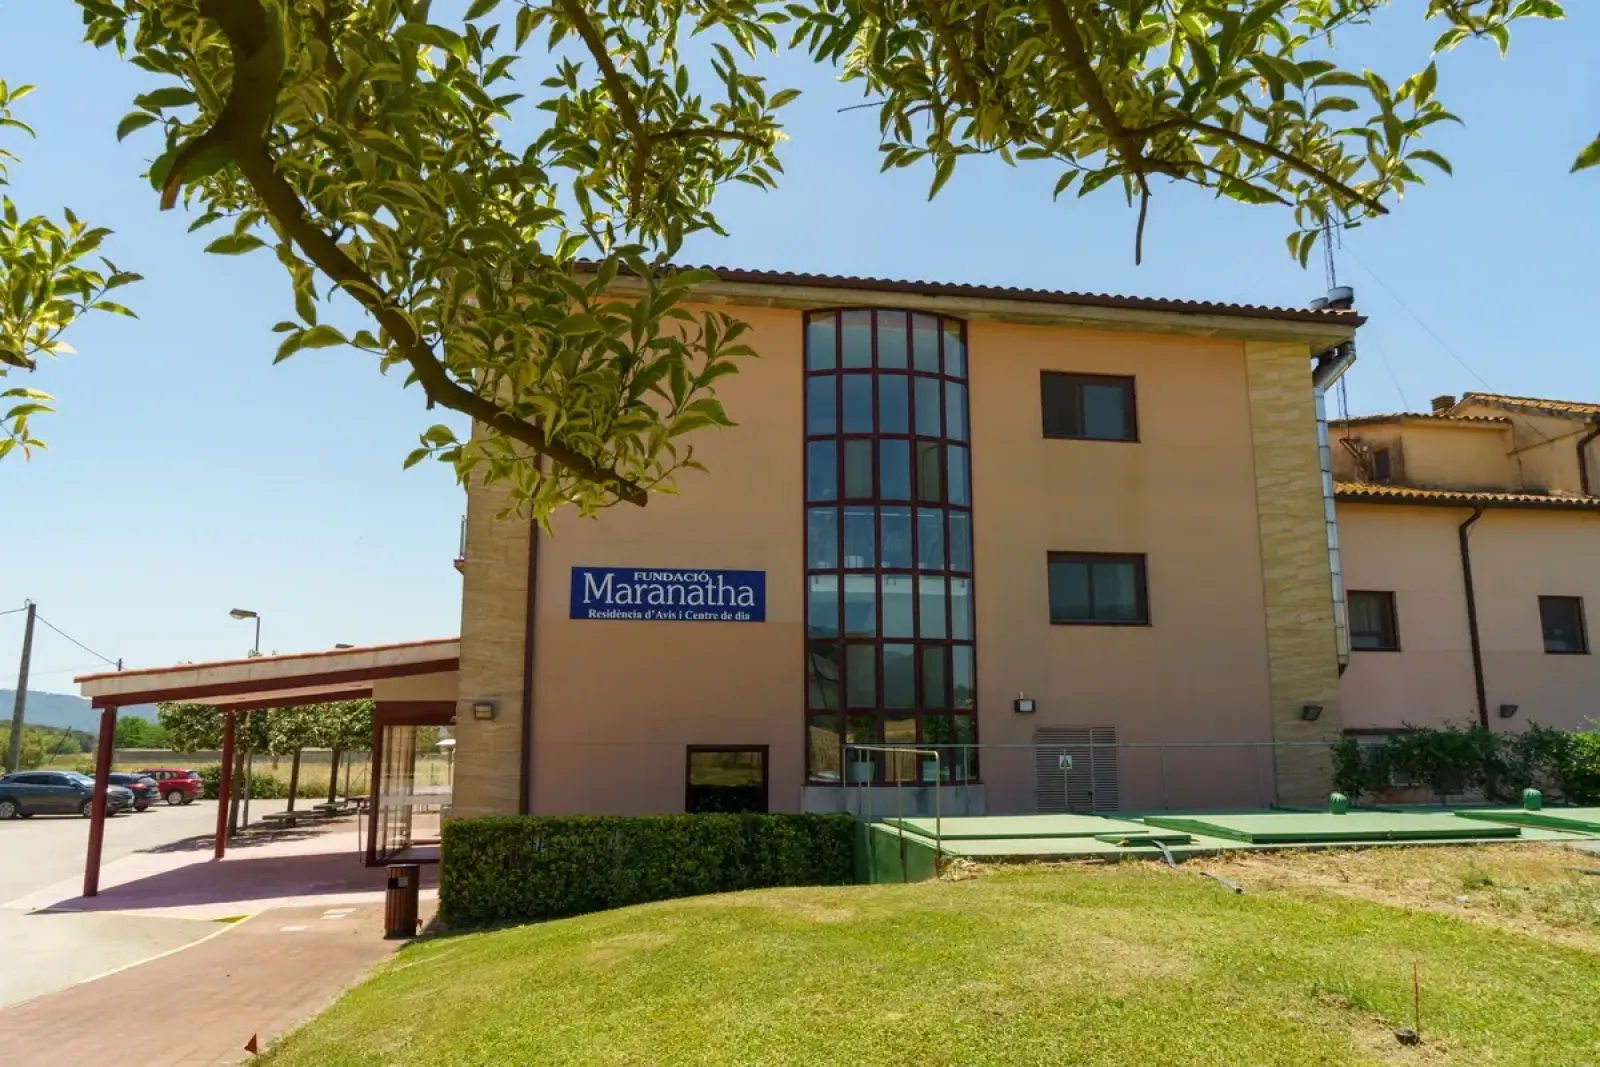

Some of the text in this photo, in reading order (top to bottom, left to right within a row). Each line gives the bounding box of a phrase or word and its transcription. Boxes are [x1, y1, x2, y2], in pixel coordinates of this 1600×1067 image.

[633, 571, 709, 582] FUNDACIÓ
[582, 572, 755, 607] Maranatha
[588, 608, 642, 619] Residència
[644, 609, 677, 620] d'Avis
[684, 610, 719, 620] Centre
[720, 611, 733, 620] de
